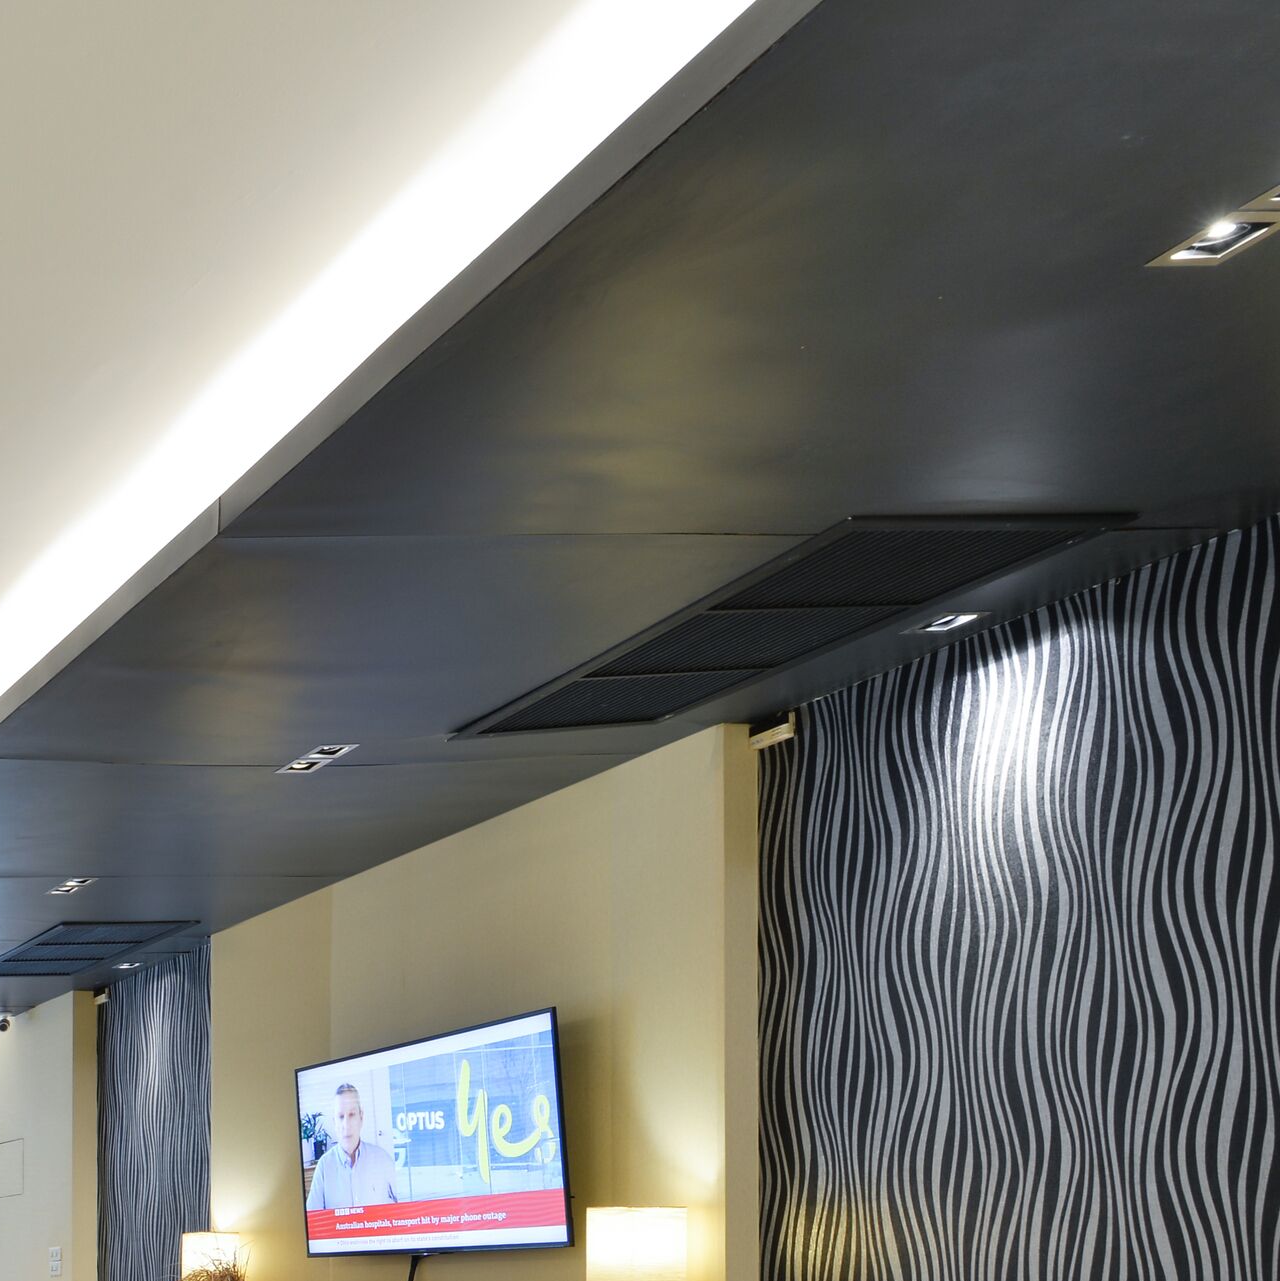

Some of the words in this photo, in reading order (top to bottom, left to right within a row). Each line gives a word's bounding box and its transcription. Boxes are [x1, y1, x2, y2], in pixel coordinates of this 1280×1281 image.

[396, 1110, 446, 1132] OPTUS
[336, 1222, 364, 1230] Australian
[392, 1217, 420, 1227] transport
[421, 1216, 431, 1225] hit
[431, 1215, 440, 1225] by
[440, 1214, 460, 1224] major
[460, 1213, 482, 1223] phone
[482, 1212, 507, 1221] outage
